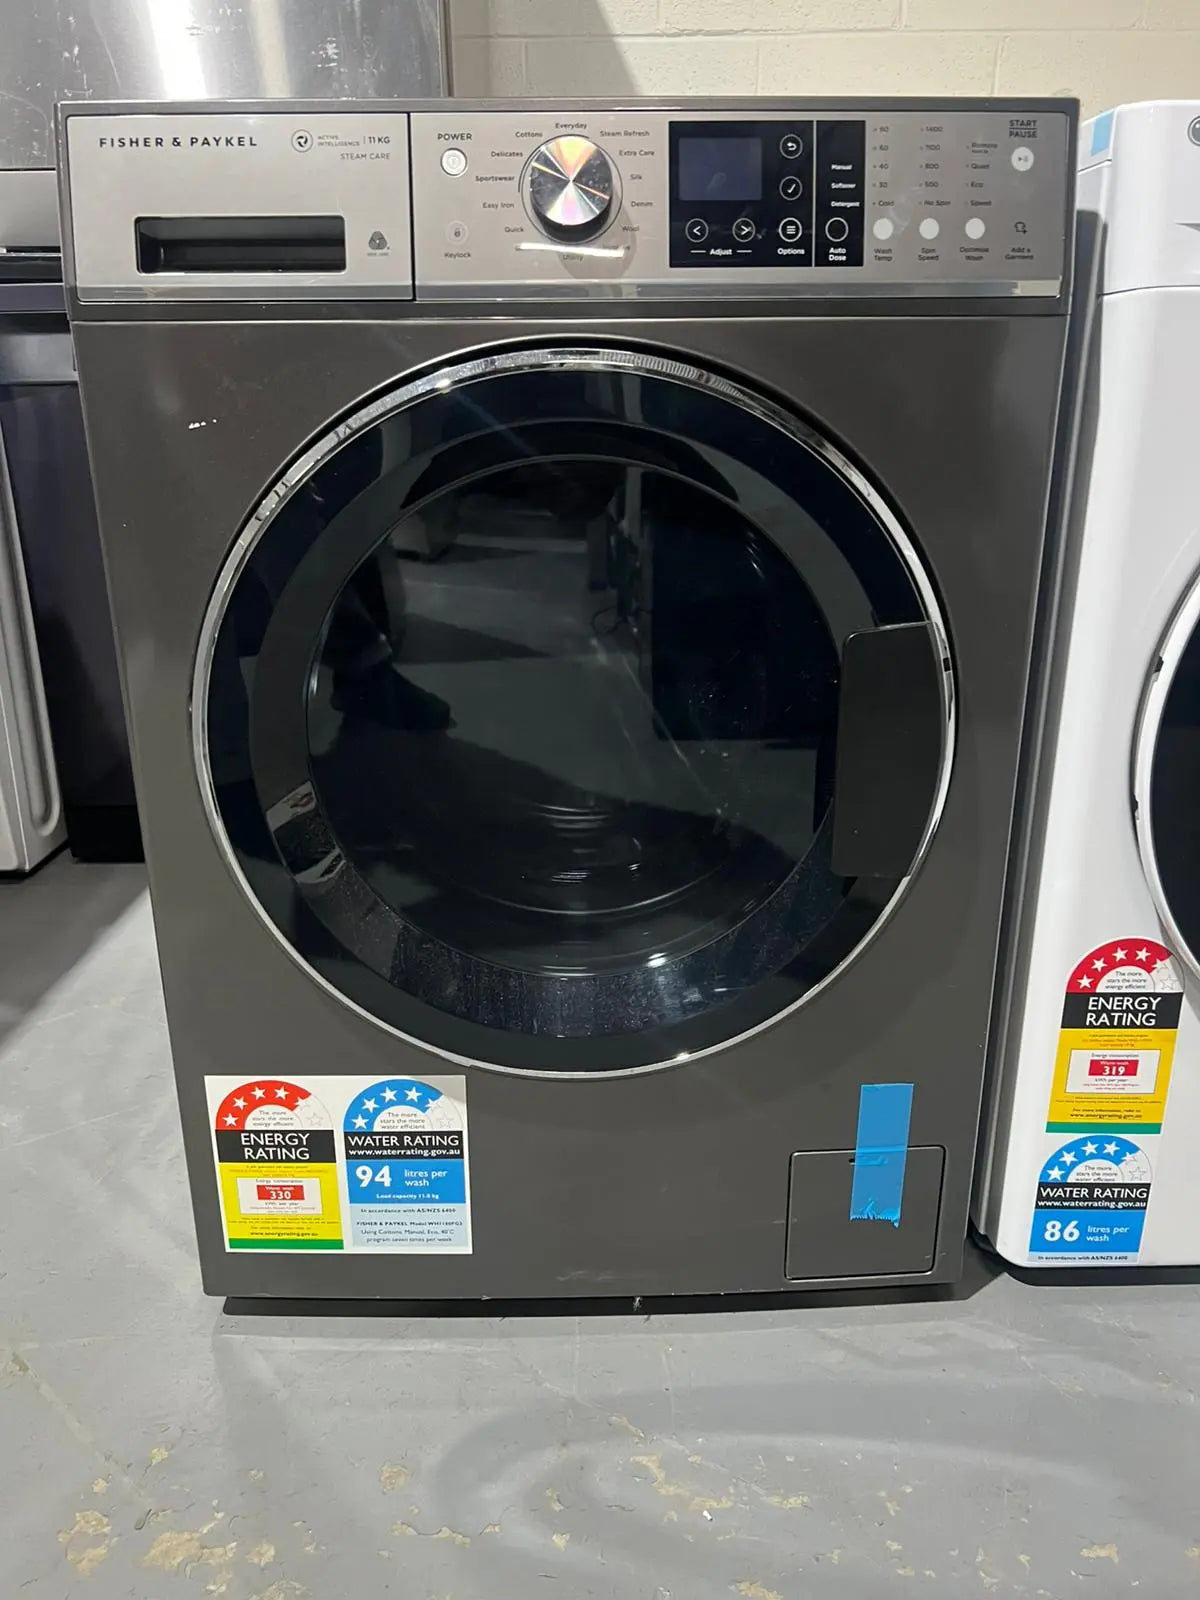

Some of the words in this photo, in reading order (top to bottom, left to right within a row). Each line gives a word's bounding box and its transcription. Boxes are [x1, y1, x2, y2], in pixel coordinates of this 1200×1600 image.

[555, 122, 587, 130] Everyday
[437, 133, 472, 141] POWER
[600, 130, 622, 138] Steam
[623, 130, 650, 138] Refresh
[99, 137, 164, 148] FISHER
[172, 137, 181, 148] &
[190, 136, 257, 147] PAYKEL
[368, 136, 376, 144] 11
[377, 136, 390, 144] KG
[619, 149, 638, 157] Extra
[639, 149, 655, 157] Care
[475, 175, 515, 183] Sportswear
[482, 202, 498, 210] Easy
[504, 226, 524, 234] Quick
[444, 251, 472, 260] Keylock
[709, 248, 732, 256] Adjust
[777, 247, 805, 256] Options
[1088, 997, 1162, 1011] ENERGY
[1085, 1013, 1157, 1026] RATING
[1102, 1066, 1126, 1075] 319
[241, 1133, 310, 1146] ENERGY
[348, 1136, 398, 1146] WATER
[404, 1135, 459, 1146] RATING
[244, 1147, 310, 1160] RATING
[349, 1148, 460, 1158] www.waterrating.gov.au
[355, 1165, 392, 1188] 94
[404, 1169, 429, 1177] litres
[431, 1170, 448, 1179] per
[404, 1178, 429, 1187] wash
[270, 1191, 291, 1200] 330
[1040, 1187, 1089, 1199] WATER
[1094, 1188, 1148, 1199] RATING
[1038, 1200, 1146, 1209] www.waterrating.gov.au
[1044, 1220, 1080, 1242] 86
[1088, 1225, 1110, 1233] litres
[1113, 1226, 1130, 1235] per
[1086, 1234, 1109, 1242] wash
